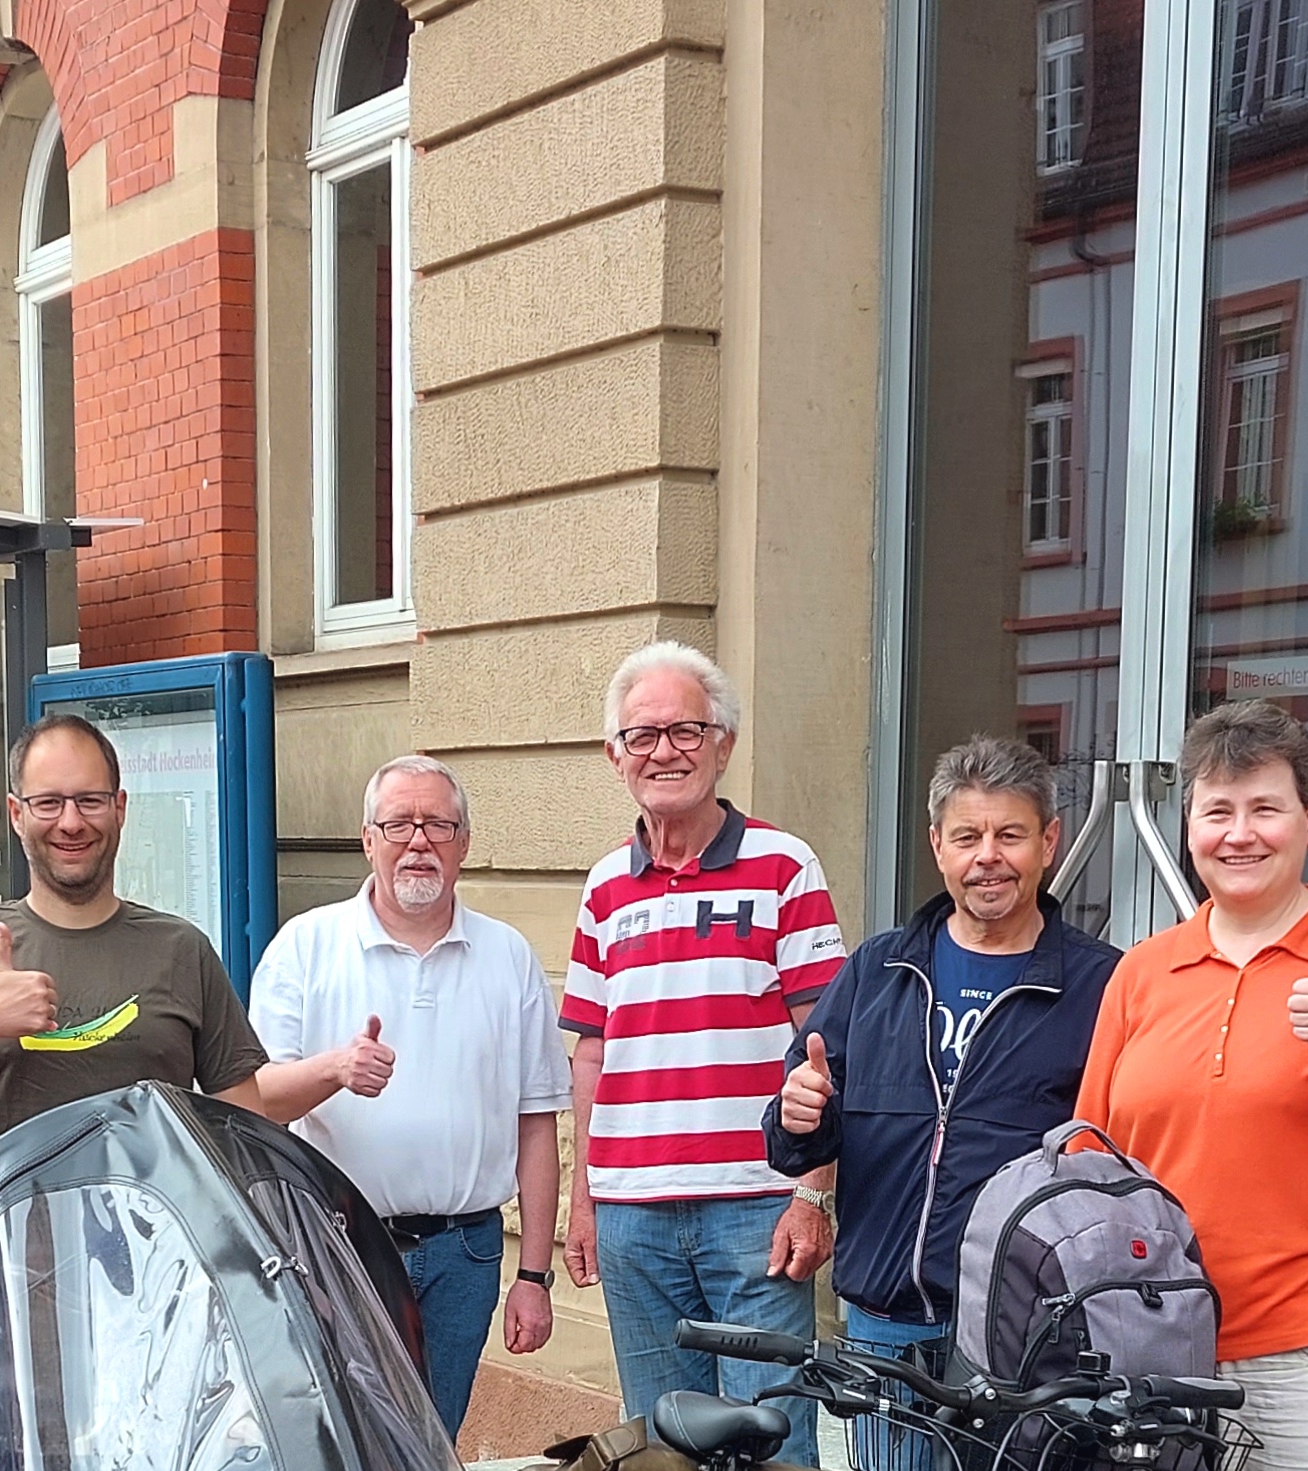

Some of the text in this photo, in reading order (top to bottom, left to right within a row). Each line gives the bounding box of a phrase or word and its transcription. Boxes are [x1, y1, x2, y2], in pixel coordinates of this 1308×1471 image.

[1233, 671, 1260, 689] Bitte
[696, 900, 754, 939] H
[811, 937, 841, 951] HECH
[959, 988, 993, 1001] SINCE
